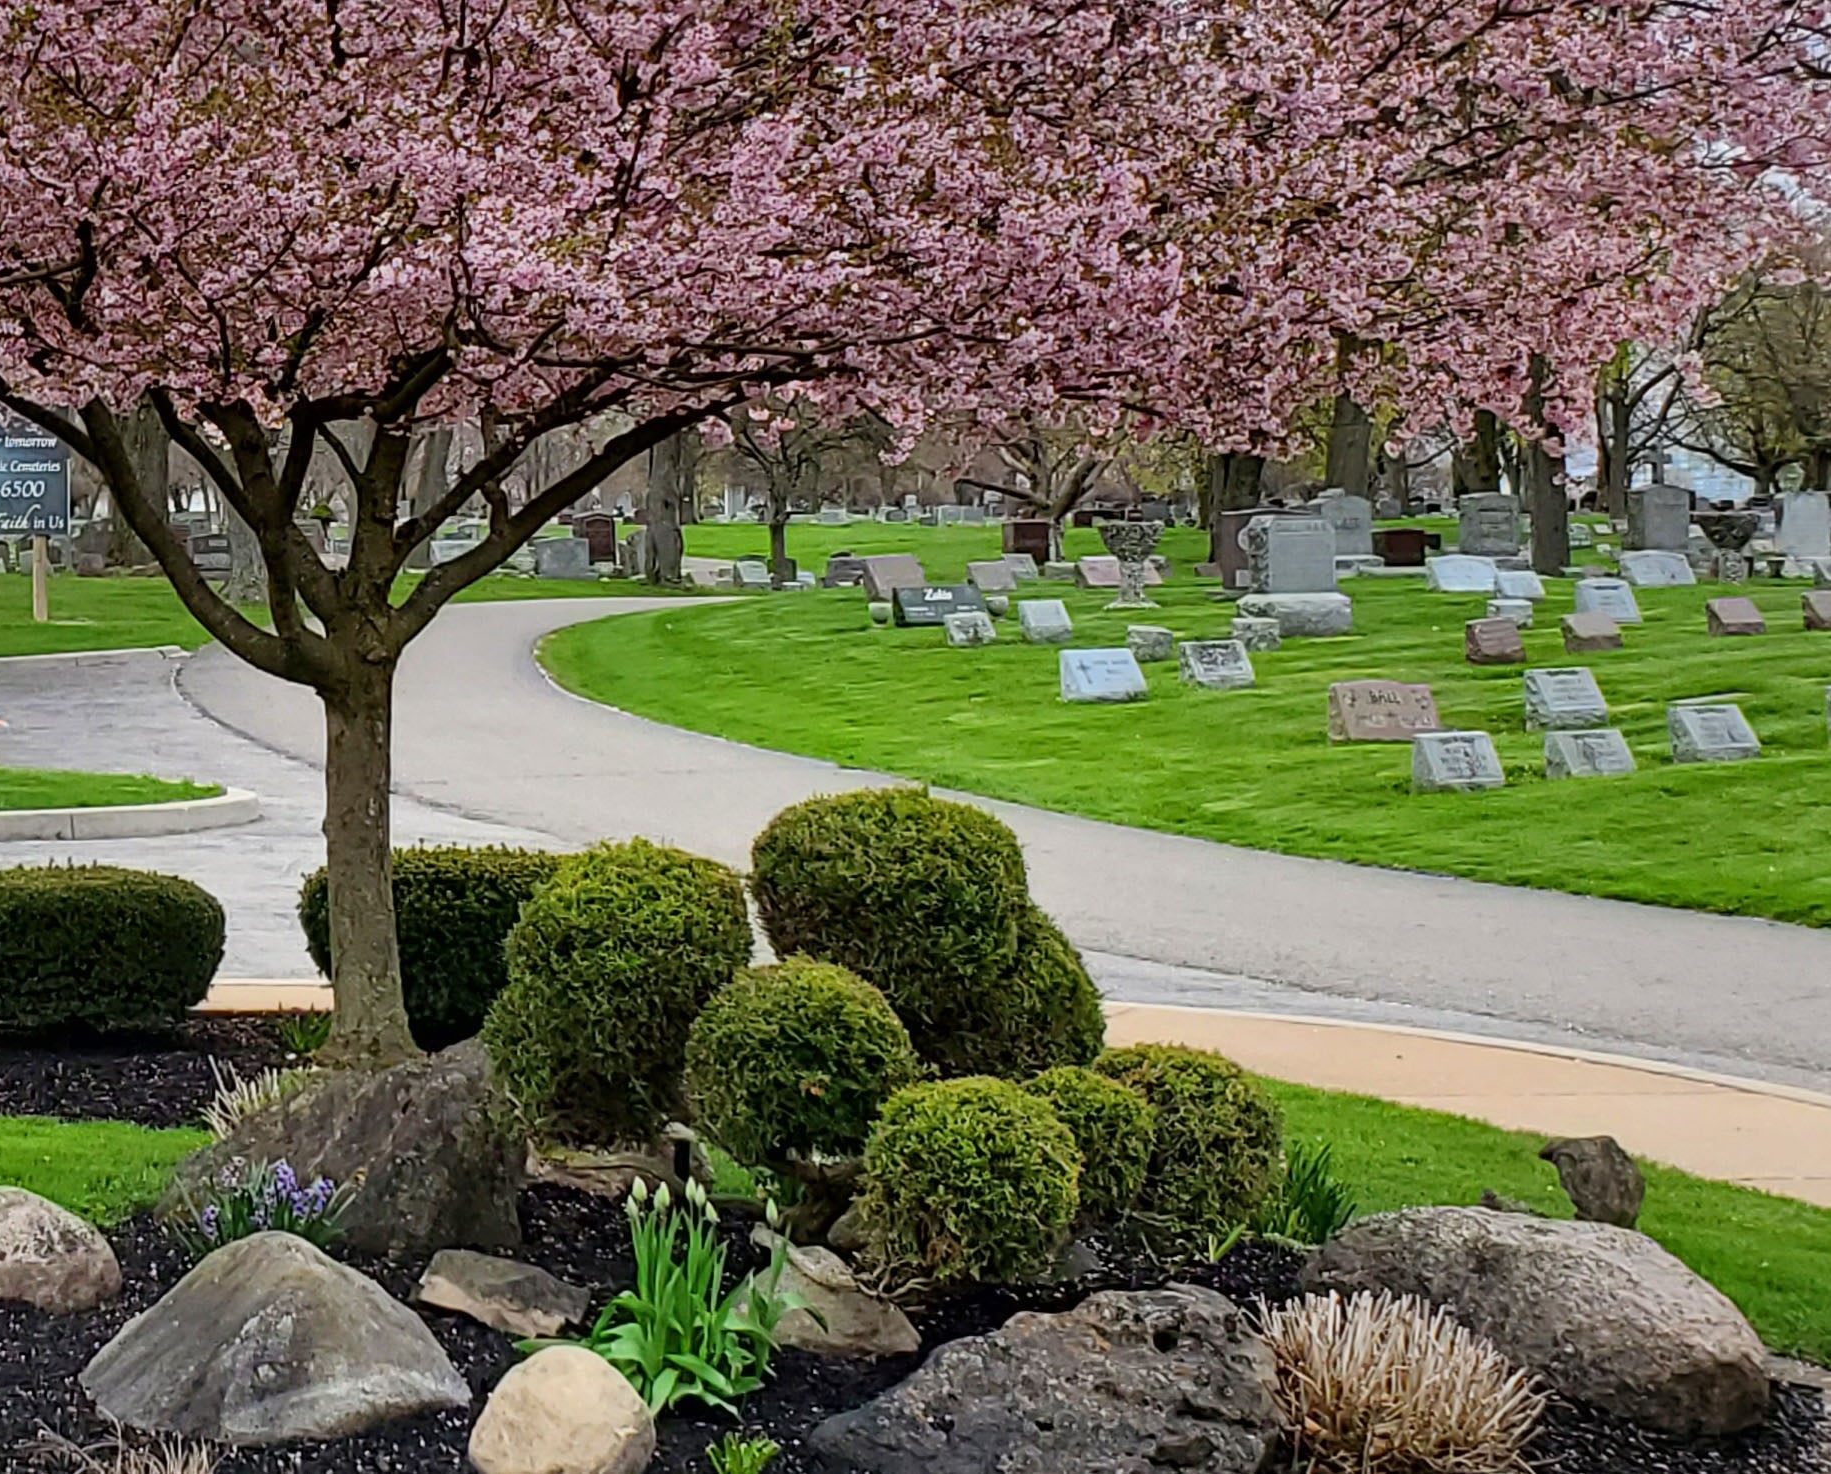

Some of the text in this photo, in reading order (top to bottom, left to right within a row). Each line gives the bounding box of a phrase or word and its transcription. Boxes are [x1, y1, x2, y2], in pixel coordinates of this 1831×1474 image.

[4, 436, 58, 448] tomorrow
[10, 460, 61, 472] Cemeteries
[33, 515, 46, 529] in
[49, 515, 65, 529] Us
